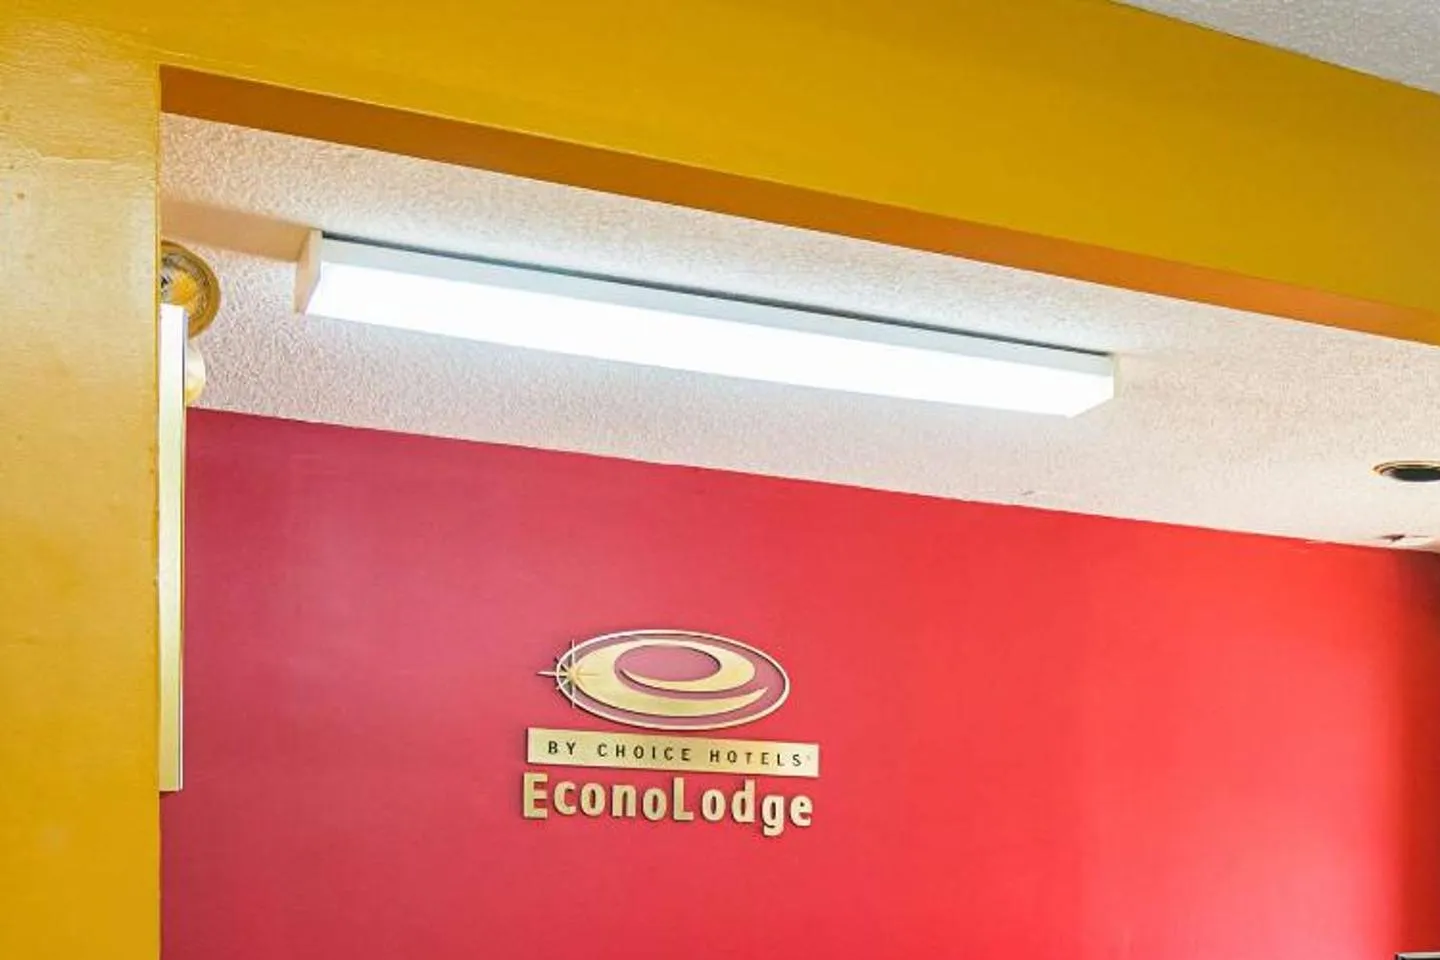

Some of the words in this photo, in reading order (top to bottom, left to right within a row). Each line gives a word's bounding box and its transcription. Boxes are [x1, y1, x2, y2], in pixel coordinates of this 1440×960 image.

[548, 741, 576, 756] BY
[598, 743, 691, 761] CHOICE
[710, 750, 802, 766] HOTELS
[522, 772, 814, 836] EconoLodge
